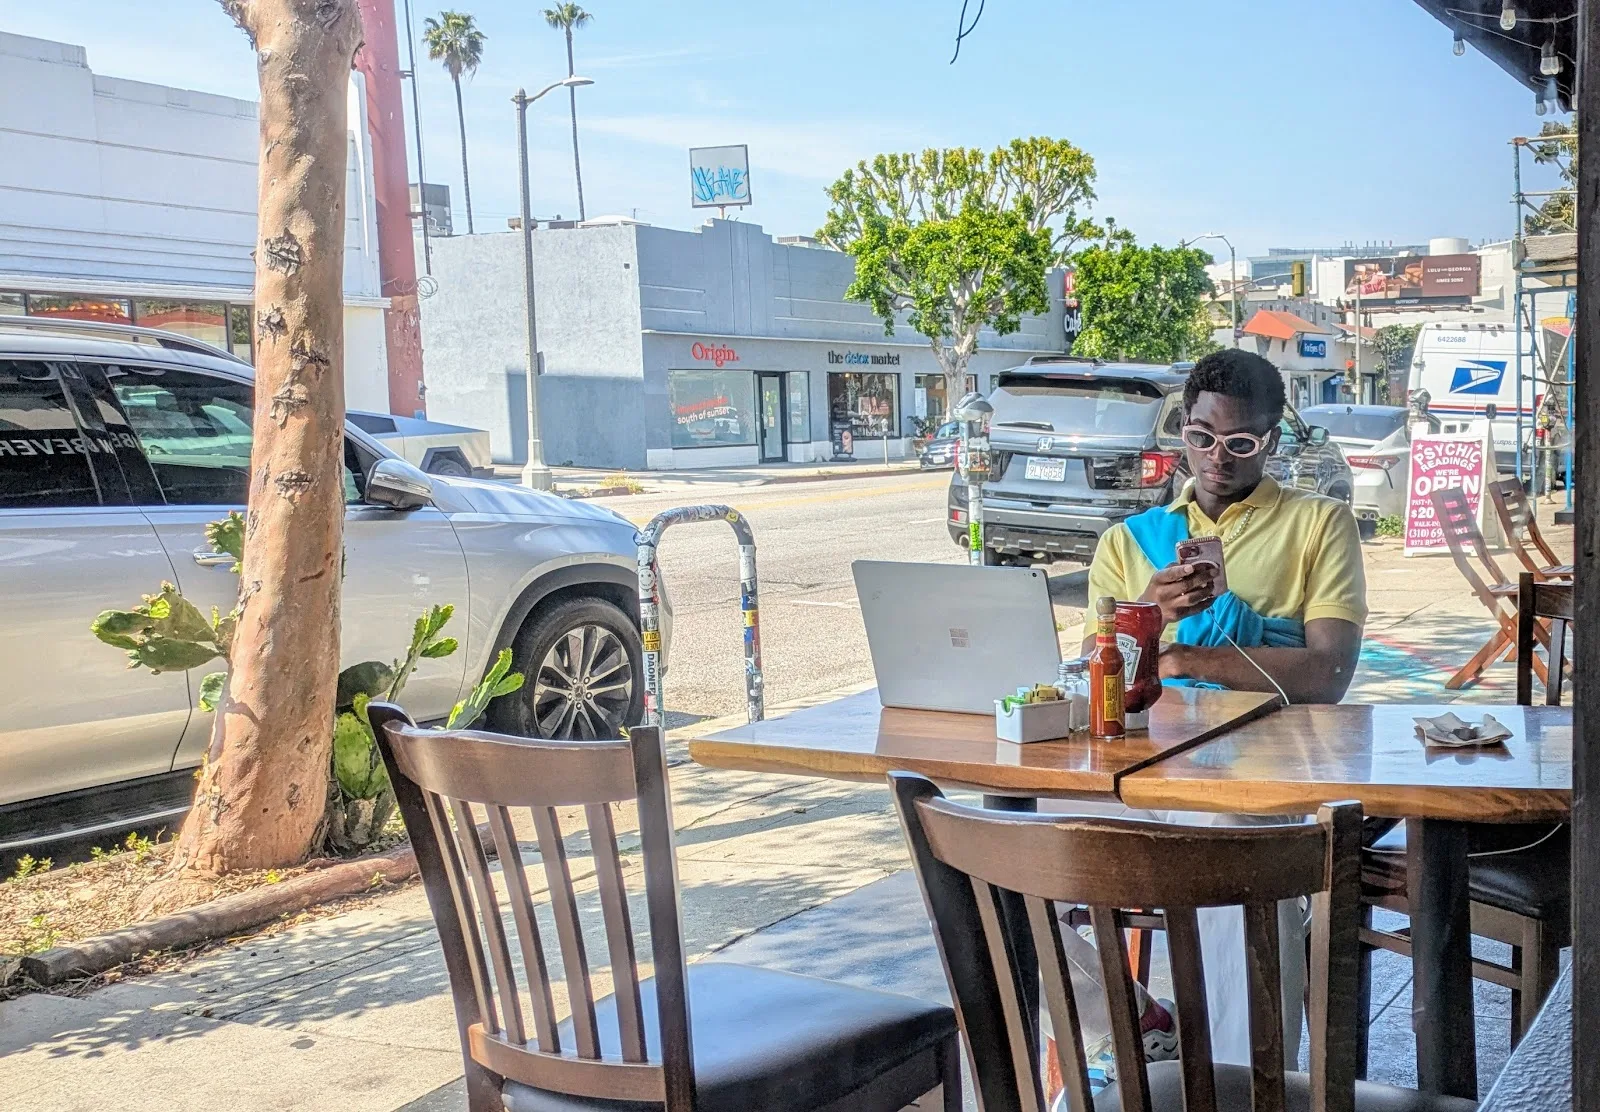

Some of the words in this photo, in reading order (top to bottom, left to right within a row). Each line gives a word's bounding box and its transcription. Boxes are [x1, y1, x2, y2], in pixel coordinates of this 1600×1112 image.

[828, 350, 843, 364] the
[845, 350, 869, 364] detox
[871, 351, 900, 366] market
[677, 412, 698, 425] south
[698, 409, 706, 420] of
[706, 406, 730, 418] sunset
[1413, 443, 1482, 465] PSYCHIC
[1420, 456, 1475, 473] READINGS
[1435, 468, 1460, 476] WE'RE
[1415, 475, 1480, 497] OPEN
[1411, 506, 1435, 519] $20
[1409, 528, 1429, 538] (310)
